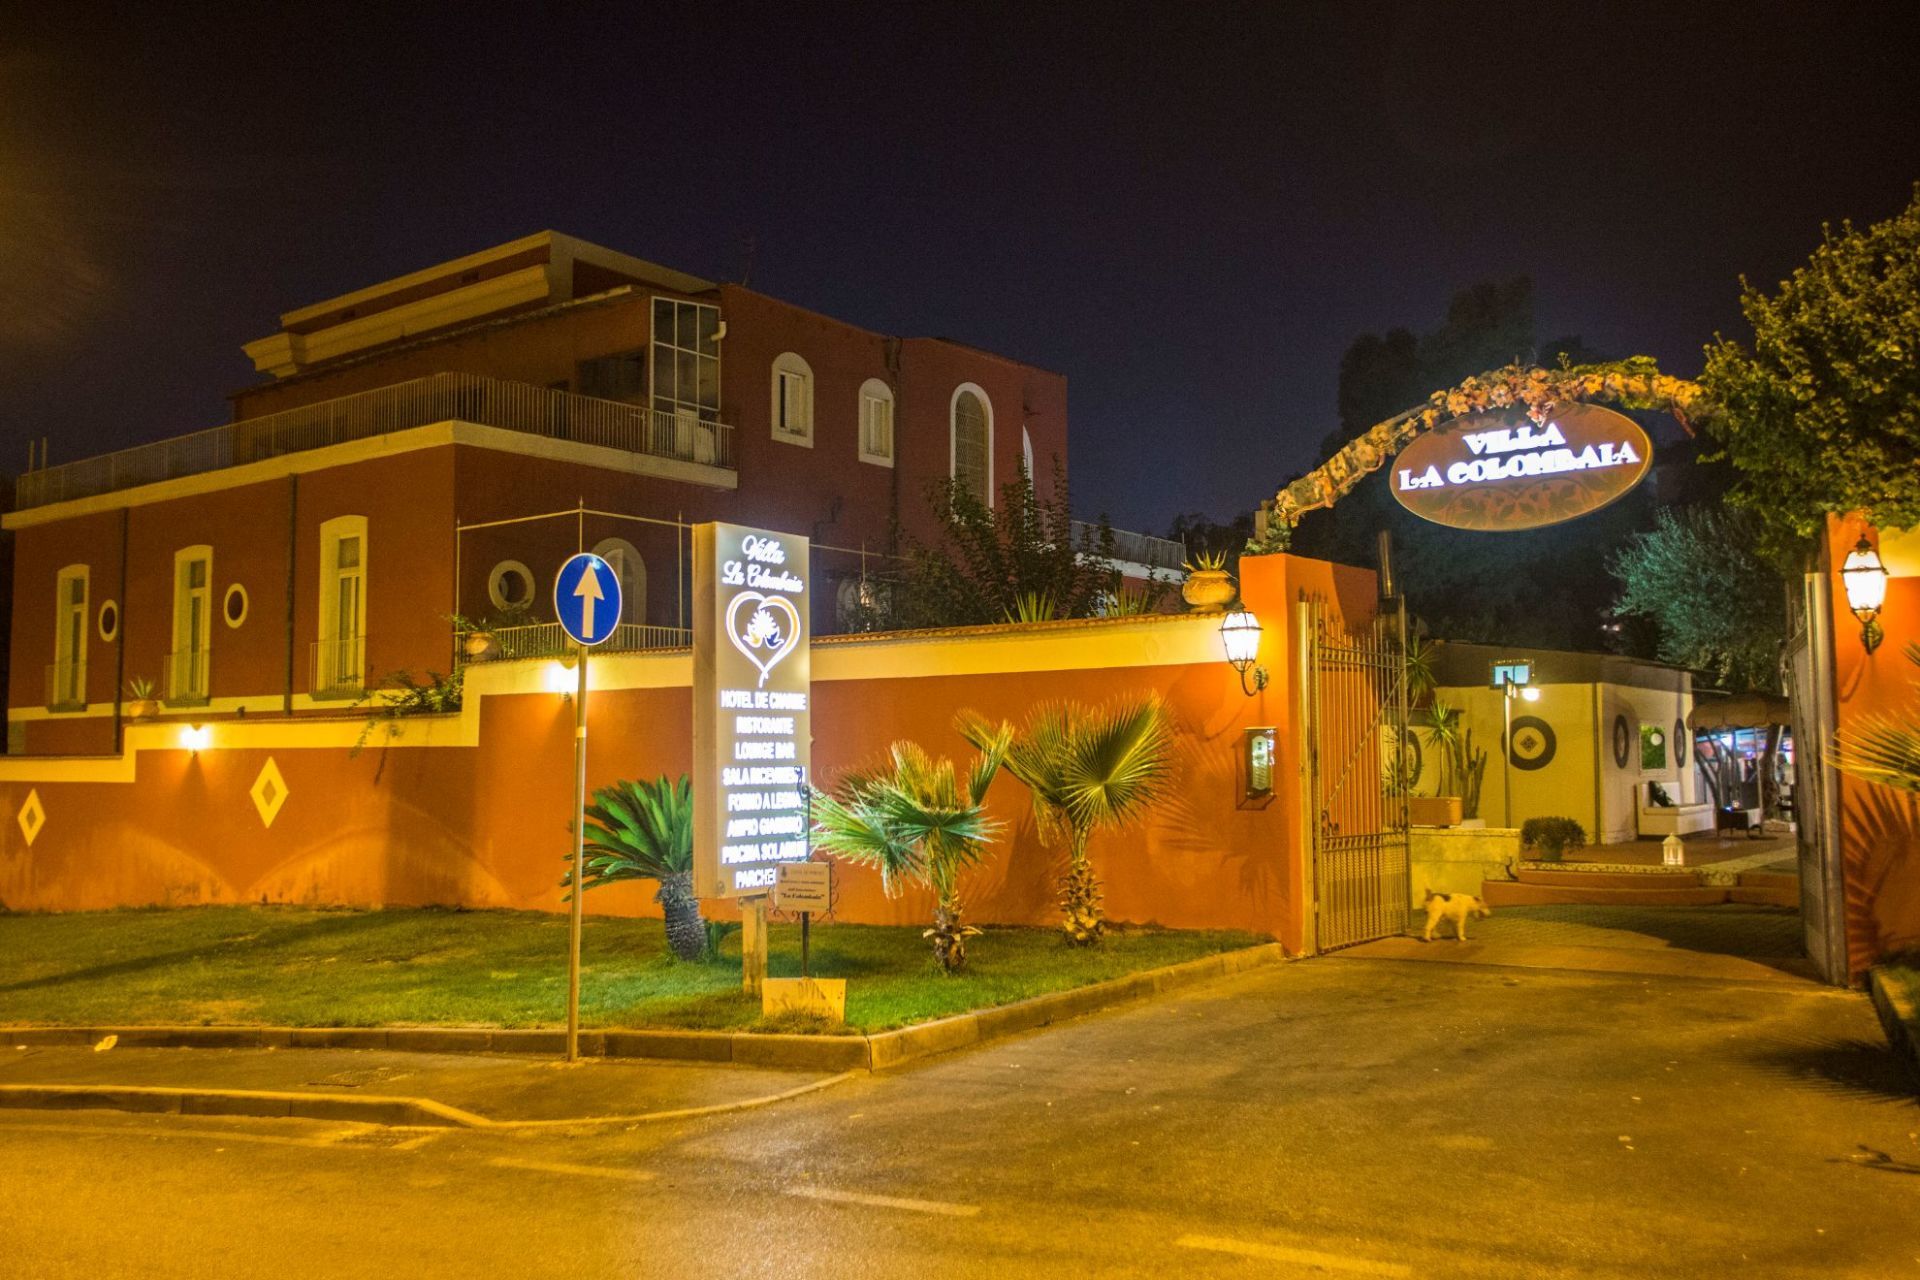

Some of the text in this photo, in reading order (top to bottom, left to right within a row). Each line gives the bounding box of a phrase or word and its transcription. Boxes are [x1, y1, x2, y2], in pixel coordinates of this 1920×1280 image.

[1463, 423, 1566, 454] VILLA
[1399, 466, 1444, 490] LA
[742, 535, 785, 564] Villa
[722, 560, 803, 593] La Colombaia
[721, 690, 753, 708] HOTEL
[755, 692, 768, 708] DE
[736, 717, 793, 734] RISTORANTE
[735, 742, 795, 759] LOUNGE BAR
[723, 767, 806, 785] SALA RICEVIMENI
[728, 793, 762, 811] FORNO
[763, 793, 770, 809] A
[727, 818, 758, 837] AMPIO
[722, 841, 807, 864] PISCINA SOLARIUM
